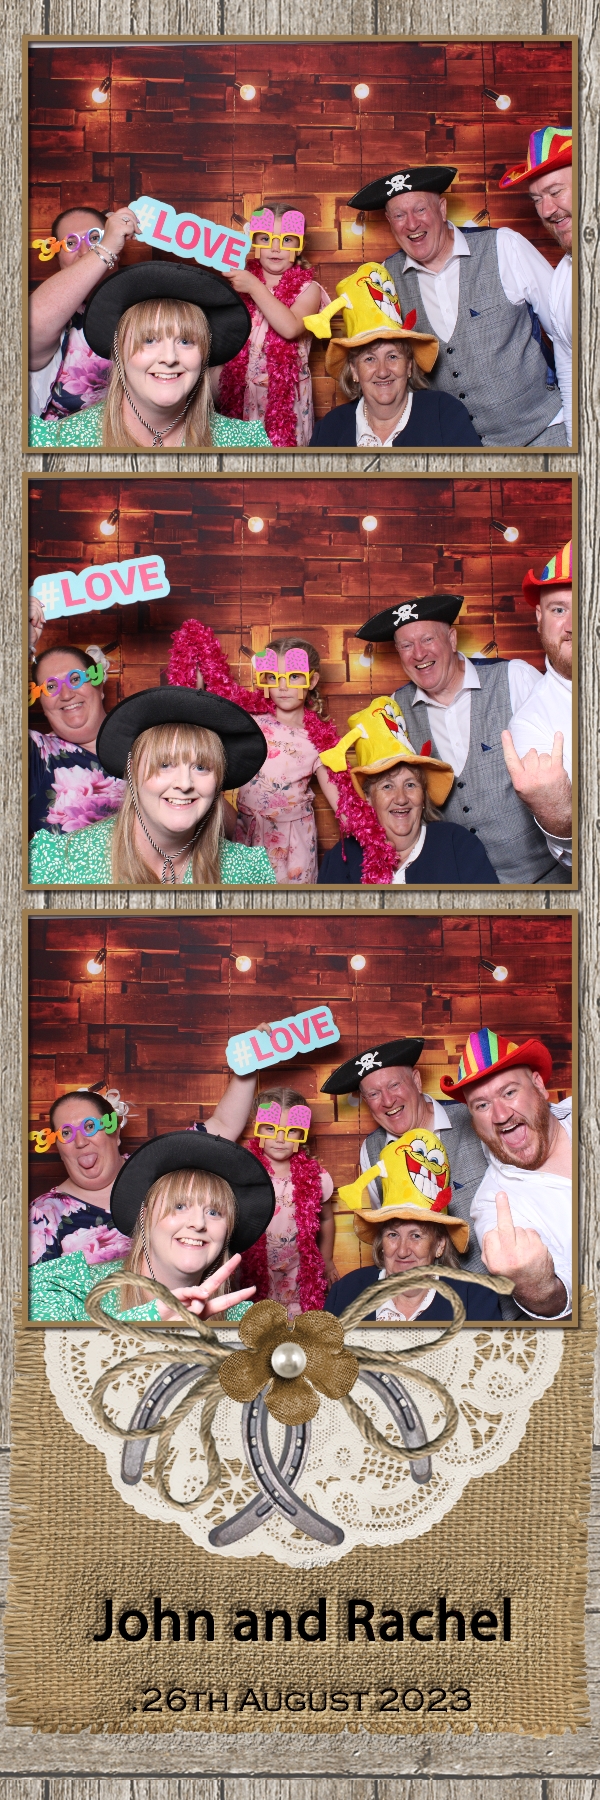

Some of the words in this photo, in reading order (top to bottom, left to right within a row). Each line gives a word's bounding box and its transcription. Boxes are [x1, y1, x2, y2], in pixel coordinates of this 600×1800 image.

[136, 203, 246, 269] #LOVE
[36, 561, 164, 613] #LOVE
[232, 1011, 335, 1069] #LOVE
